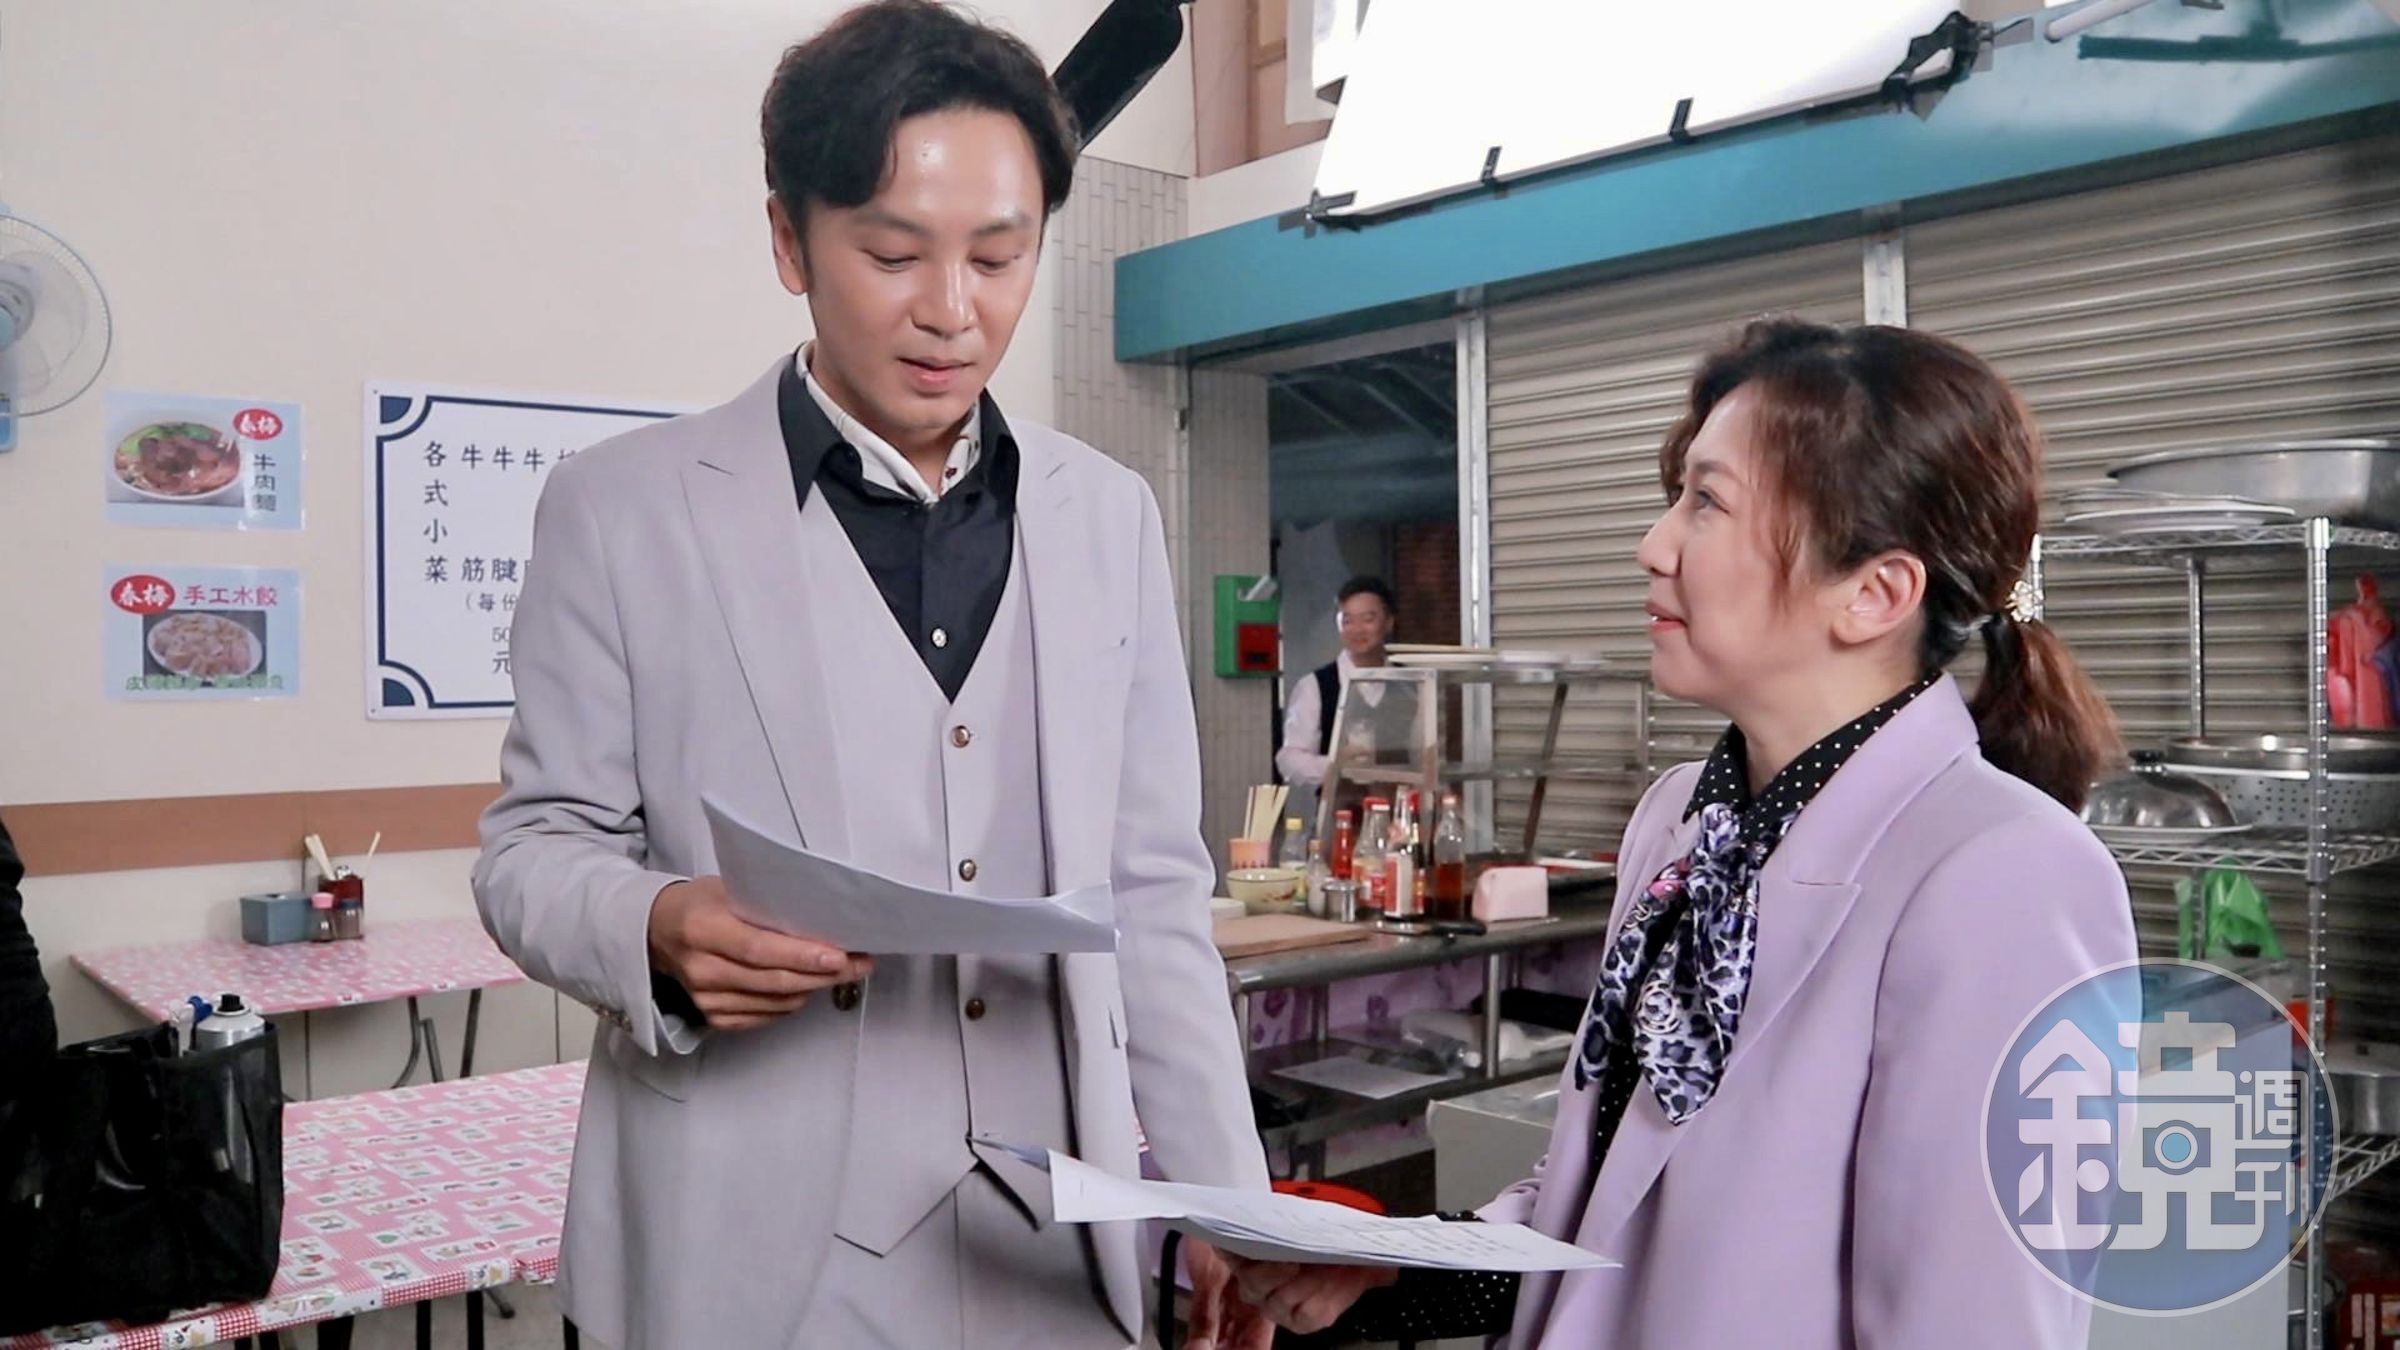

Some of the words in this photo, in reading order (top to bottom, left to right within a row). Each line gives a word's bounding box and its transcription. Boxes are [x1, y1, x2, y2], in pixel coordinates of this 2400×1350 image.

[424, 440, 448, 583] 各式小菜
[184, 585, 278, 607] 手工水餃
